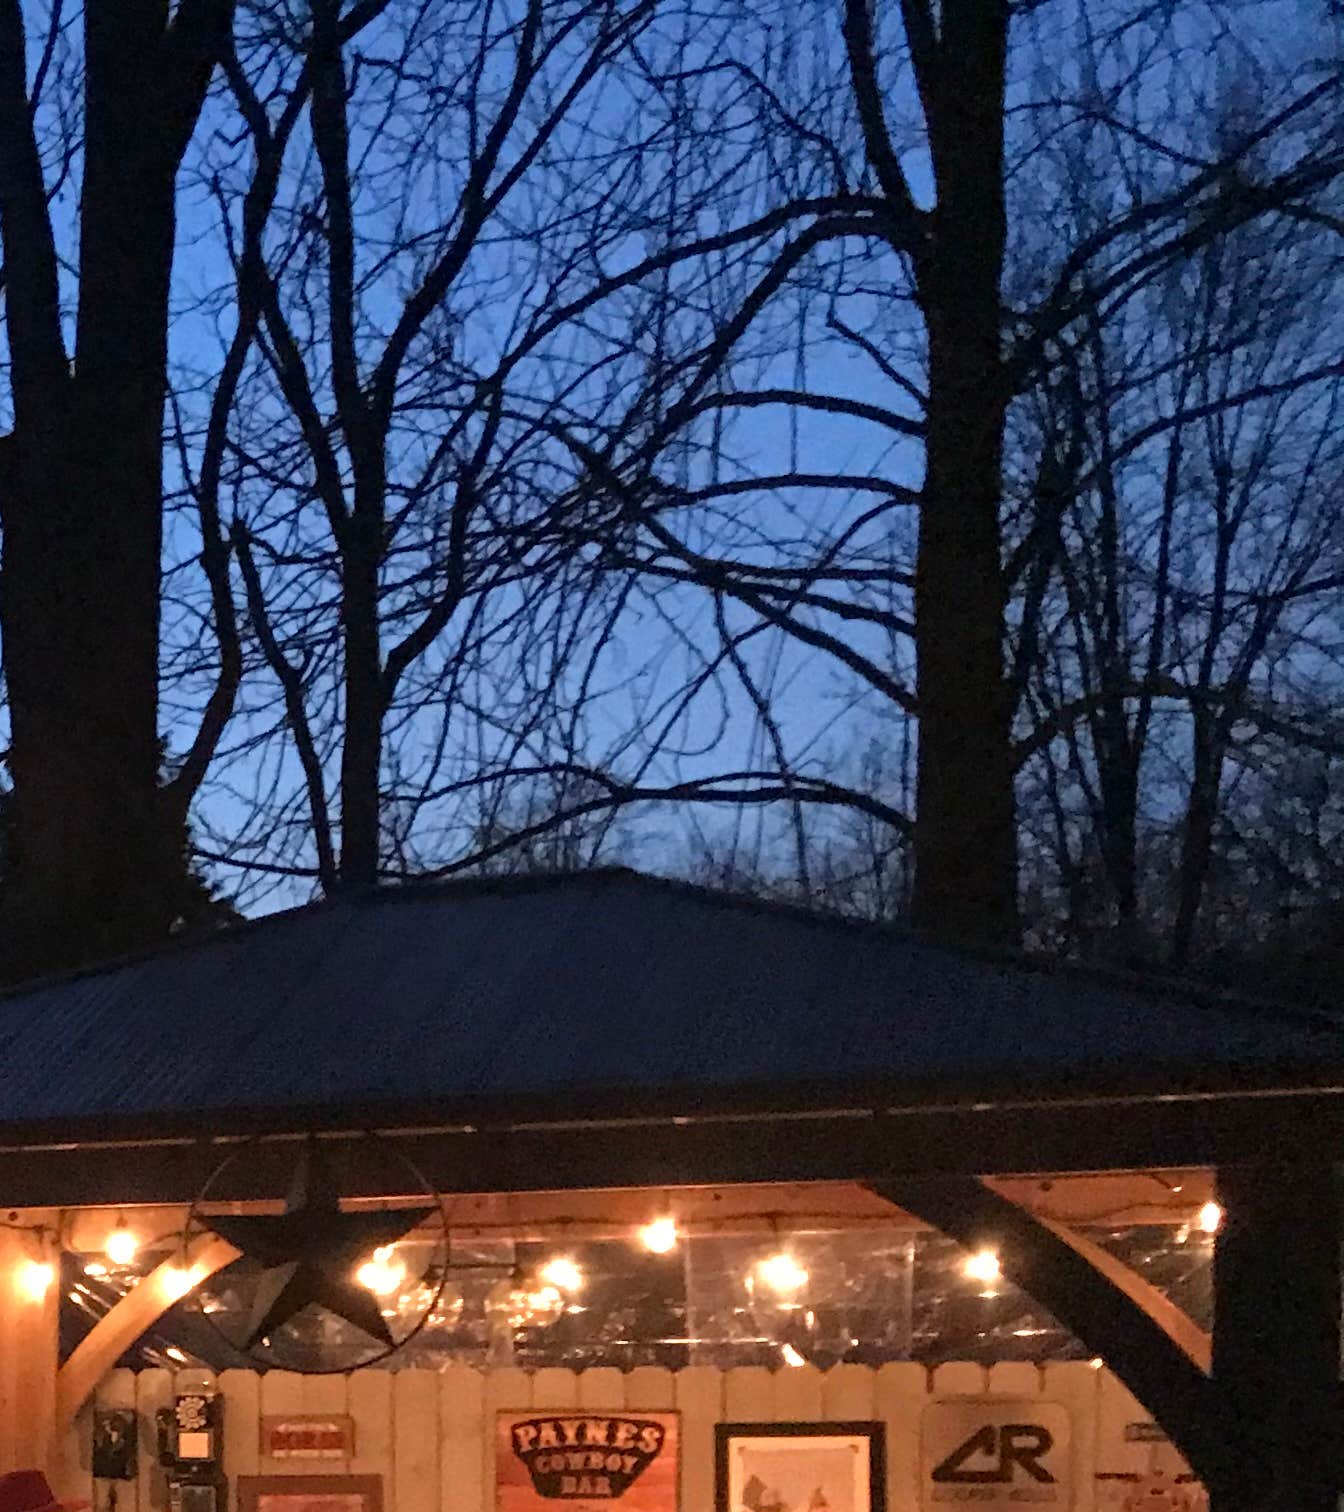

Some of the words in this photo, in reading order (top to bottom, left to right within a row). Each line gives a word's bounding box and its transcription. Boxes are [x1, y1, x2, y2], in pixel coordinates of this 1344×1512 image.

[515, 1420, 661, 1453] PAYNES
[534, 1451, 639, 1474] COWBOY
[562, 1476, 611, 1495] BAR
